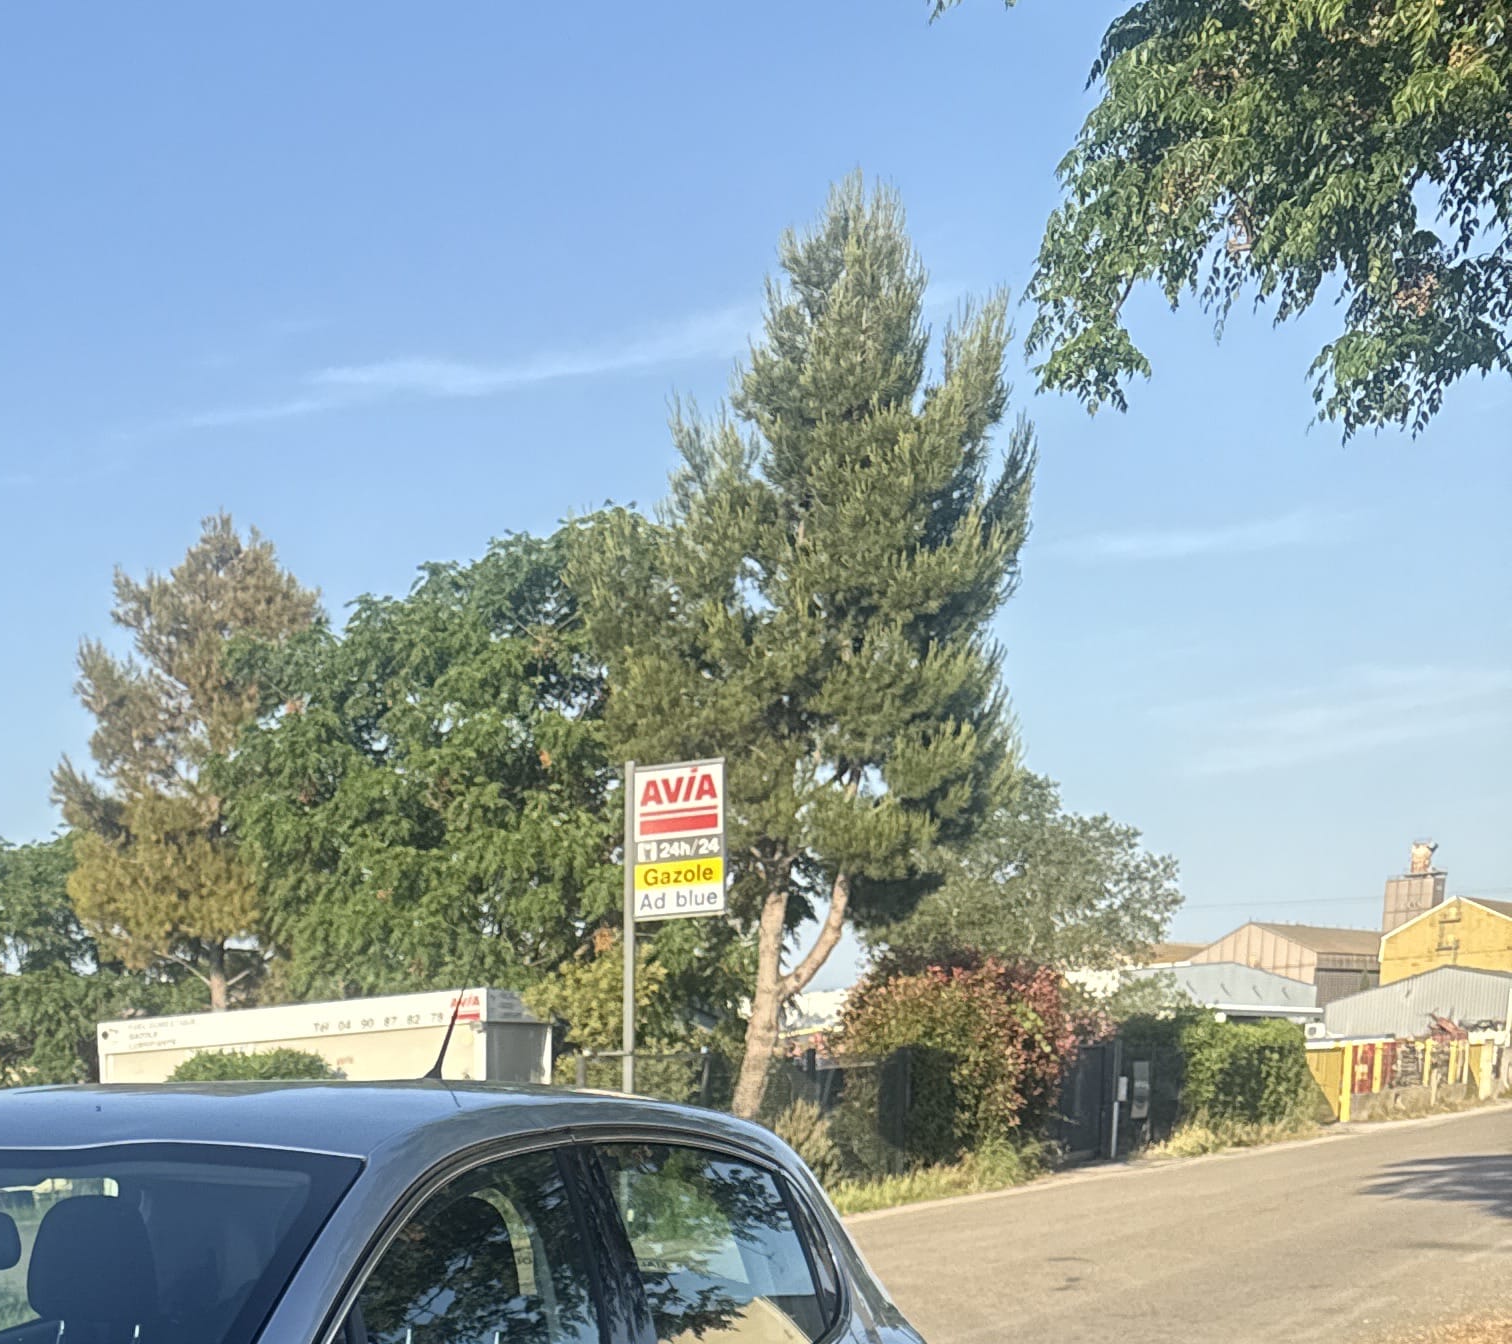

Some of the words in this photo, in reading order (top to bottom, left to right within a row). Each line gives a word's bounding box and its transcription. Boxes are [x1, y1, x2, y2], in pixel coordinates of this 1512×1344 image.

[640, 767, 718, 807] AVIA
[659, 838, 720, 858] 24h/24
[643, 864, 714, 886] Gazole
[640, 892, 666, 911] Ad
[676, 890, 718, 907] blue
